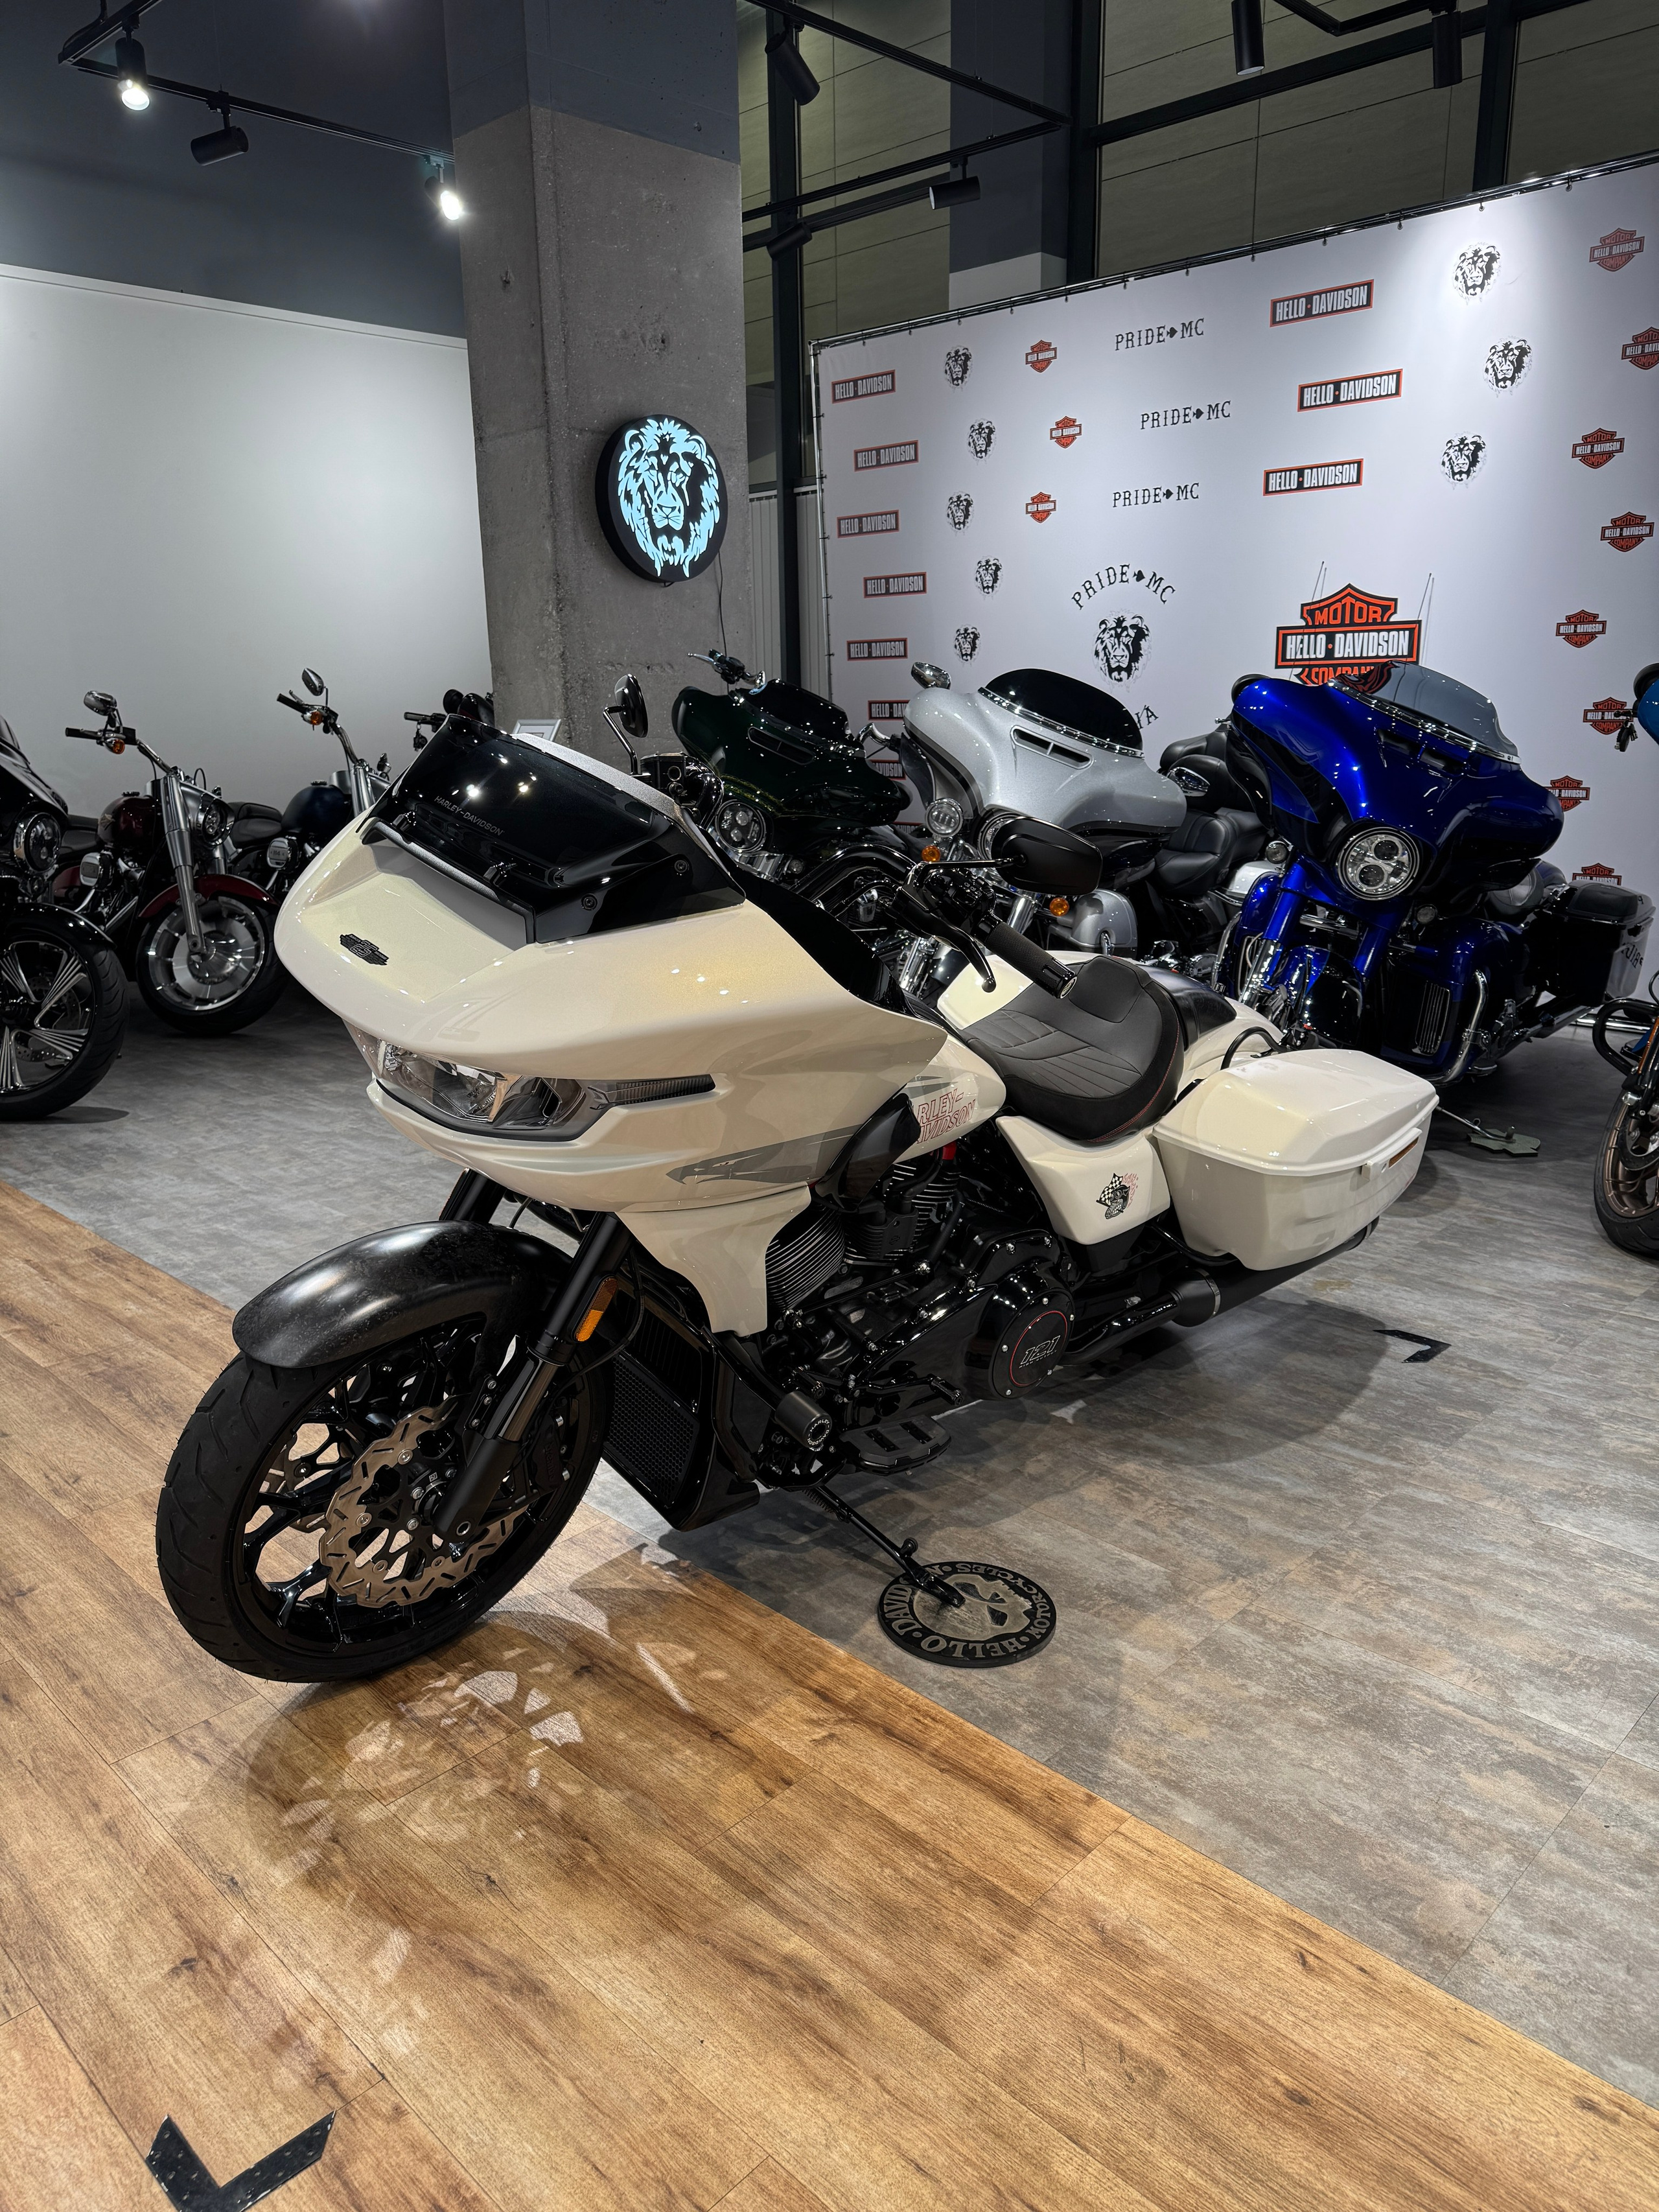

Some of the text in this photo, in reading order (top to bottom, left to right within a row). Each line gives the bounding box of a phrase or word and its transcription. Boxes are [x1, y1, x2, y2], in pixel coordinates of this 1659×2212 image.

[1605, 232, 1630, 244] MOTOR
[1594, 240, 1640, 258] HELLO DAVIDSON
[1275, 285, 1368, 322] HELLO DAVIDSON
[1115, 318, 1204, 351] PRIDE MC
[1638, 331, 1659, 342] MOTO
[1626, 345, 1642, 356] HELLO
[835, 374, 892, 400] HELLO DAVIDSON
[1303, 374, 1397, 407] HELLO DAVIDSON
[1140, 400, 1231, 430] PRIDE MC
[1586, 432, 1611, 443] MOTOR
[857, 444, 915, 468] HELLO DAVIDSON
[1575, 441, 1621, 455] HELLO DAVIDSON
[1268, 463, 1358, 492] HELLO DAVIDSON
[1113, 482, 1200, 507] PRIDE MC
[841, 513, 896, 535] HELLO DAVIDSON
[1616, 515, 1641, 526] MOTOR
[1604, 526, 1651, 538] HELLO DAVIDSON
[1614, 537, 1639, 549] COMPANY
[866, 576, 923, 595] HELLO DAVIDSON
[1071, 563, 1176, 611] PRIDE MC
[1314, 596, 1382, 625] MOTOR
[1570, 613, 1594, 623] MOTOR
[1577, 623, 1603, 633] DAVIDSON
[850, 641, 905, 658] HELLO DAVIDSON
[1286, 631, 1410, 660] HELLO DAVIDSON
[871, 703, 890, 717] HELLO
[1597, 701, 1621, 710] MOTOR
[1555, 779, 1578, 787] MOTOR
[1561, 789, 1587, 798] DAVIDSON
[434, 795, 504, 836] HARLEY-DAVIDSON
[1586, 867, 1610, 876] MOTOR
[916, 1088, 964, 1126] RLEY-
[1020, 1334, 1061, 1365] 121
[920, 1635, 1027, 1658] HELLO
